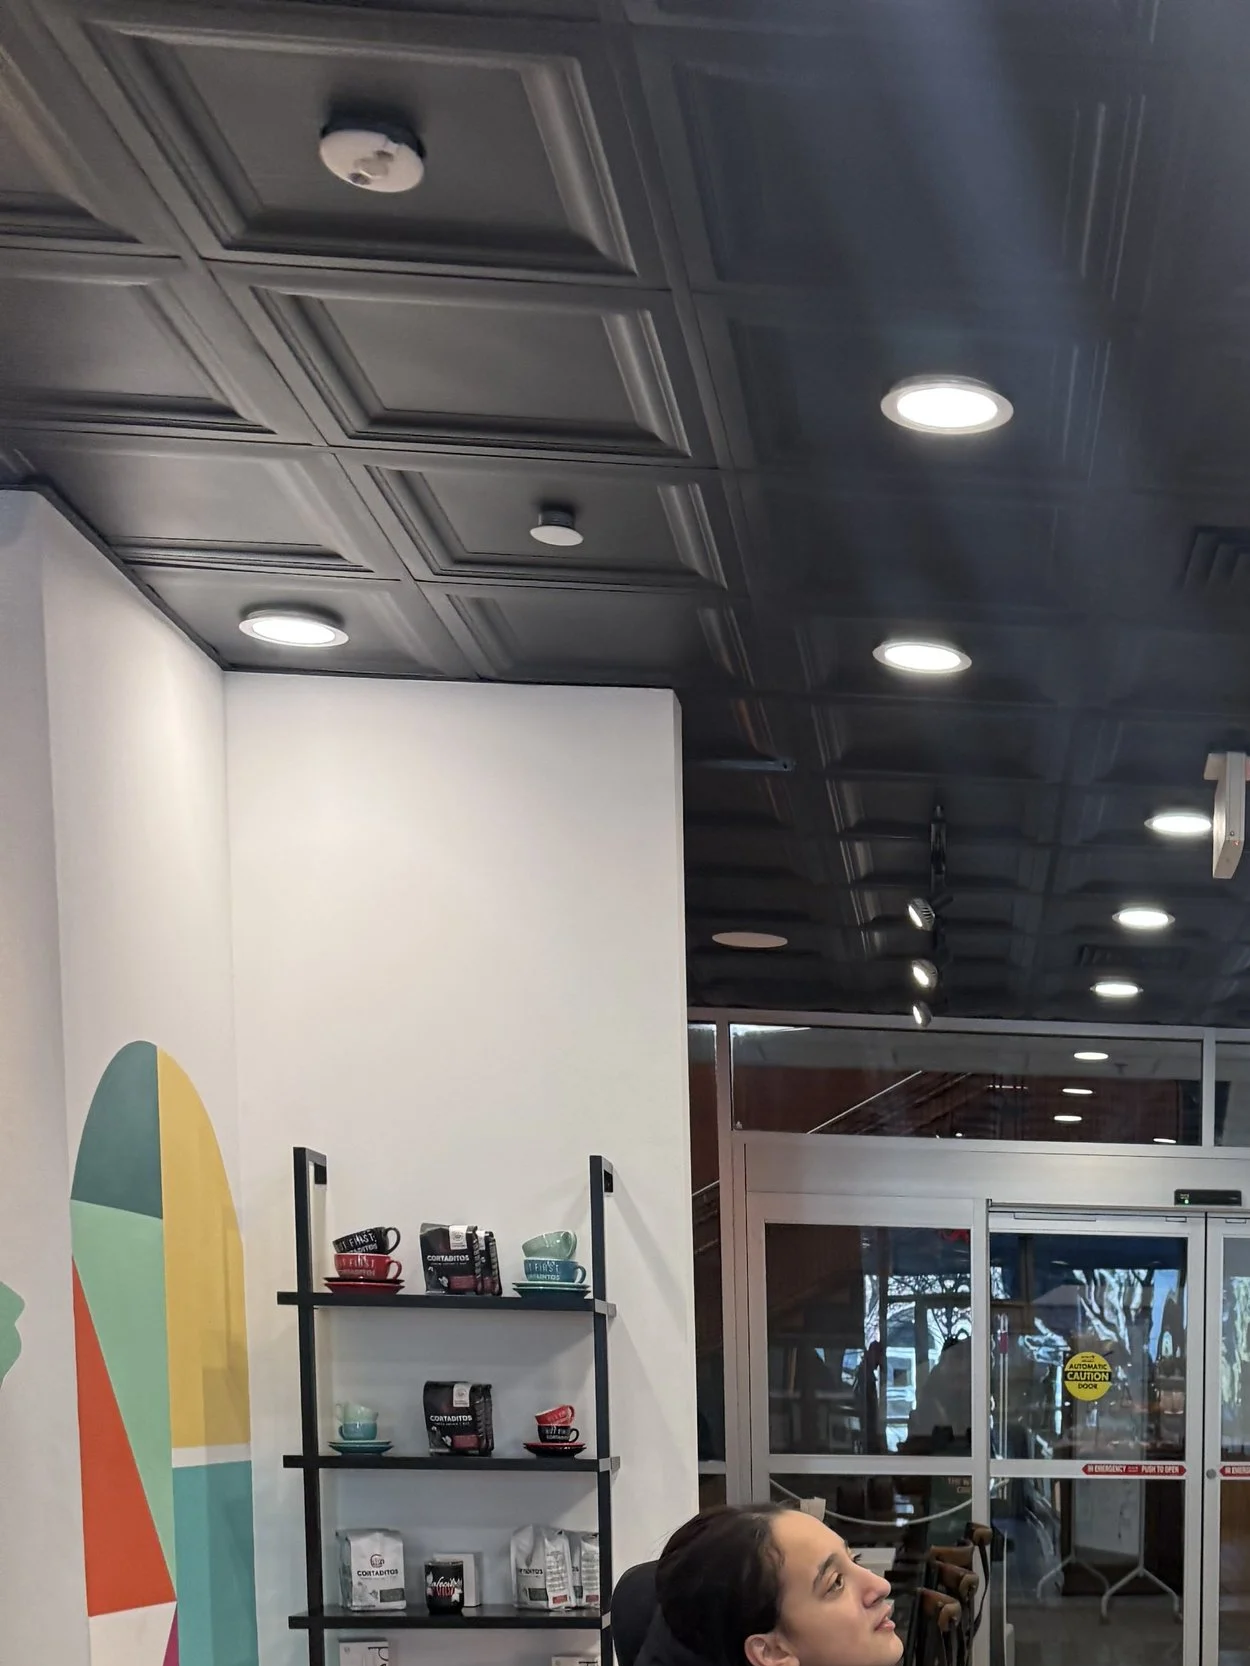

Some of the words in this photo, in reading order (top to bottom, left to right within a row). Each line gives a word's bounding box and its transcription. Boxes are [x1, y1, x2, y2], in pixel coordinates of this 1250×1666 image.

[427, 1254, 470, 1262] CORTADITOS
[1066, 1371, 1109, 1381] CAUTION
[1095, 1465, 1126, 1473] EMERGENCY
[1141, 1465, 1157, 1473] PUSH
[1157, 1465, 1164, 1473] TO
[357, 1568, 399, 1577] CORTADITOS
